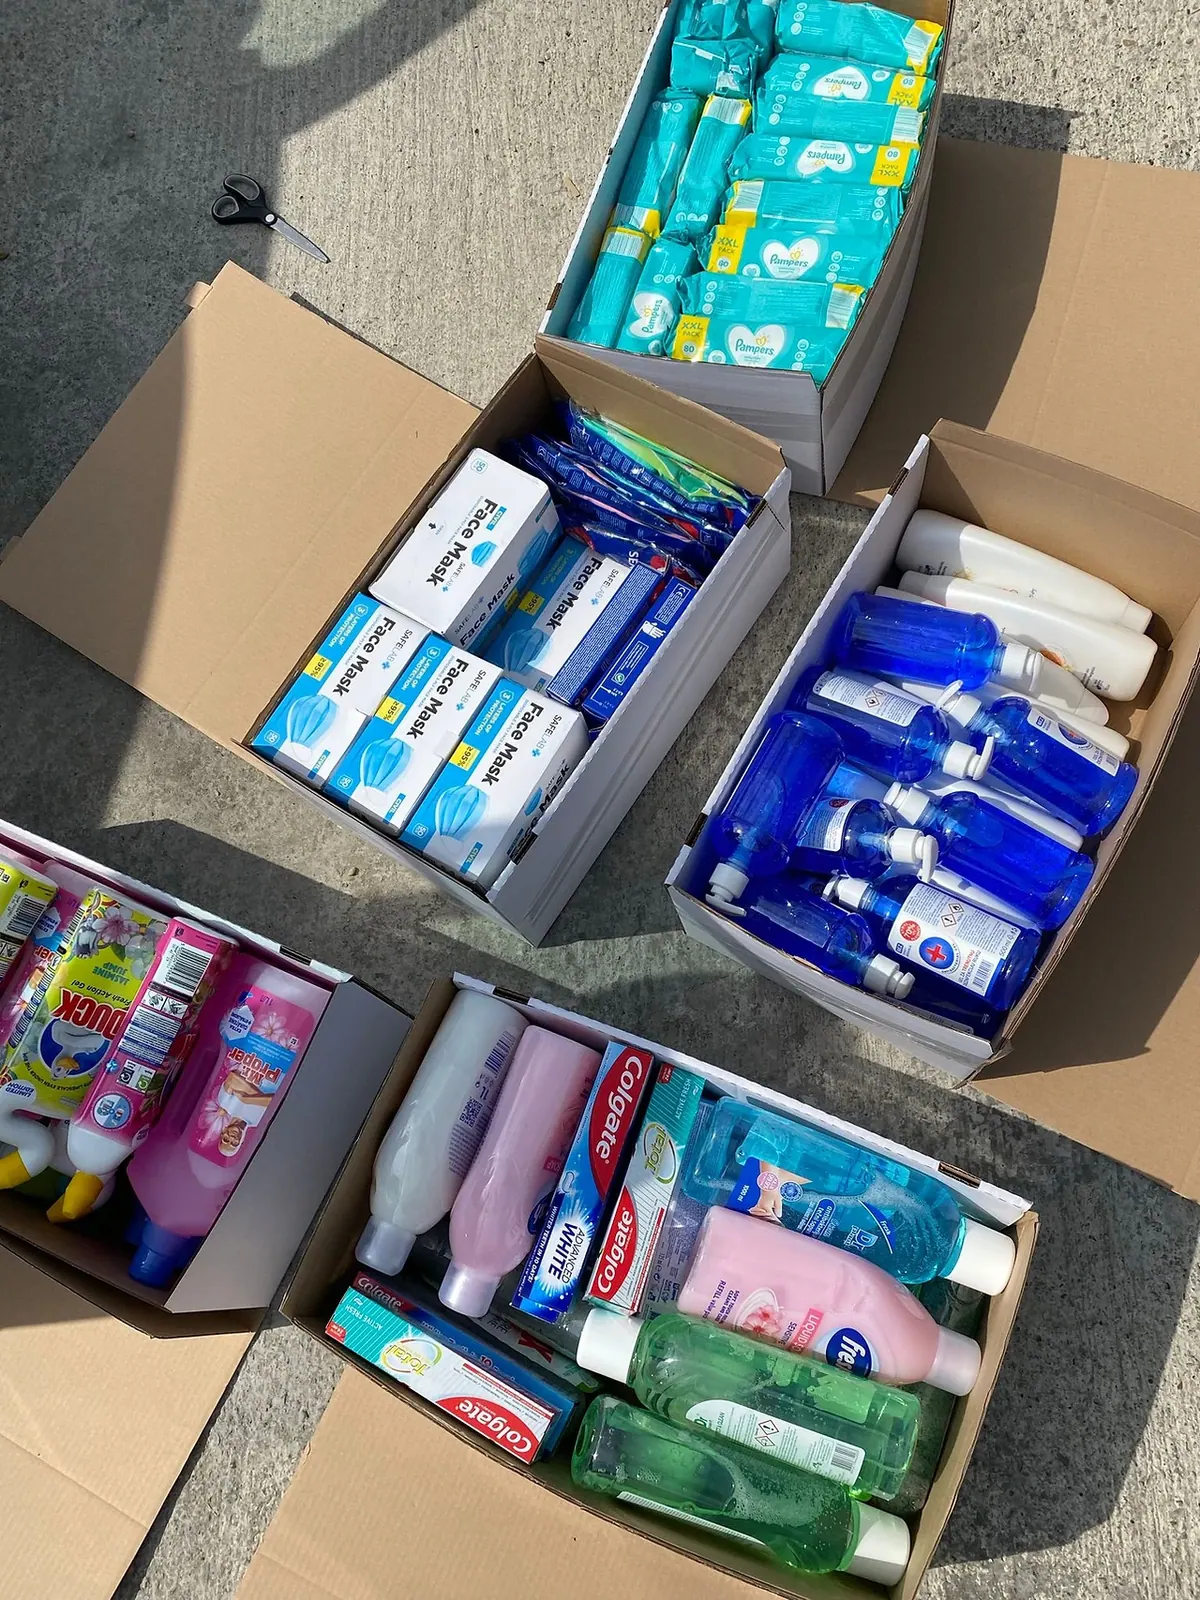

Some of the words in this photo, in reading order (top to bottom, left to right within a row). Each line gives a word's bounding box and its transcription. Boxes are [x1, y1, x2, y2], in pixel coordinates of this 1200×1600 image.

[824, 77, 862, 90] Pampers
[807, 150, 846, 164] Pampers
[717, 236, 738, 248] XXL
[769, 253, 808, 267] Pampers
[641, 298, 662, 333] Pampers
[682, 322, 703, 330] XXL
[735, 338, 774, 355] Pampers
[475, 461, 485, 471] 50
[460, 498, 497, 541] Face
[489, 509, 503, 526] CIVIL
[426, 540, 466, 588] Mask
[445, 561, 465, 586] SAFELAB
[572, 556, 602, 592] Face
[594, 567, 618, 598] SAFELAB
[458, 611, 487, 646] Face
[485, 571, 516, 610] Mask
[545, 591, 578, 631] Mask
[328, 612, 354, 647] PROTECTION
[342, 616, 359, 637] LAYERS
[362, 616, 395, 655] Face
[337, 636, 345, 645] OF
[386, 628, 412, 662] SAFELAB
[332, 654, 368, 698] Mask
[401, 655, 426, 690] PROTECTION
[415, 658, 431, 679] LAYERS
[435, 658, 468, 696] Face
[410, 678, 418, 687] OF
[460, 669, 486, 703] SAFELAB
[501, 691, 510, 700] 3
[406, 696, 442, 740] Mask
[474, 699, 500, 735] PROTECTION
[489, 702, 505, 724] LAYERS
[510, 701, 543, 742] Face
[268, 733, 277, 742] 50
[484, 723, 492, 732] OF
[535, 714, 561, 749] SAFELAB
[314, 754, 326, 769] CIVIL
[481, 742, 517, 788] Mask
[341, 777, 350, 787] 50
[388, 797, 401, 814] CIVIL
[417, 826, 426, 835] 50
[465, 847, 478, 864] CIVIL
[999, 945, 1008, 956] 500
[92, 966, 129, 985] JASMINE
[102, 961, 127, 975] JUMP
[71, 978, 85, 989] Gel
[86, 984, 110, 998] Action
[111, 994, 131, 1006] Fresh
[50, 988, 126, 1040] DUCK
[226, 1047, 281, 1082] Proper
[239, 1066, 264, 1086] Mr.
[4, 1087, 30, 1097] LIMITED
[7, 1081, 34, 1092] EDITION
[595, 1056, 639, 1159] Colgate
[674, 1097, 686, 1118] ACTIVE
[681, 1077, 692, 1098] FRESH
[643, 1127, 667, 1169] Total
[740, 1184, 749, 1195] 1000
[545, 1205, 557, 1229] WHITER
[805, 1220, 816, 1234] sapu
[539, 1229, 549, 1248] TEETH
[850, 1229, 878, 1251] Dr
[533, 1256, 539, 1264] 10
[536, 1248, 542, 1256] IN
[547, 1222, 577, 1279] WHITE
[561, 1228, 586, 1283] ADVANCED
[597, 1209, 634, 1291] Colgate
[527, 1264, 537, 1282] DAYS!
[357, 1277, 402, 1308] Colgate
[712, 1280, 726, 1299] REFILL
[731, 1290, 739, 1301] SOFT
[344, 1303, 363, 1319] FRESH
[707, 1299, 716, 1311] value
[724, 1302, 733, 1314] TOUCH
[362, 1315, 382, 1330] ACTIVE
[796, 1314, 818, 1343] LIQUID
[778, 1321, 796, 1345] SENSITIVE
[386, 1344, 427, 1375] Total
[457, 1399, 532, 1454] Colgate
